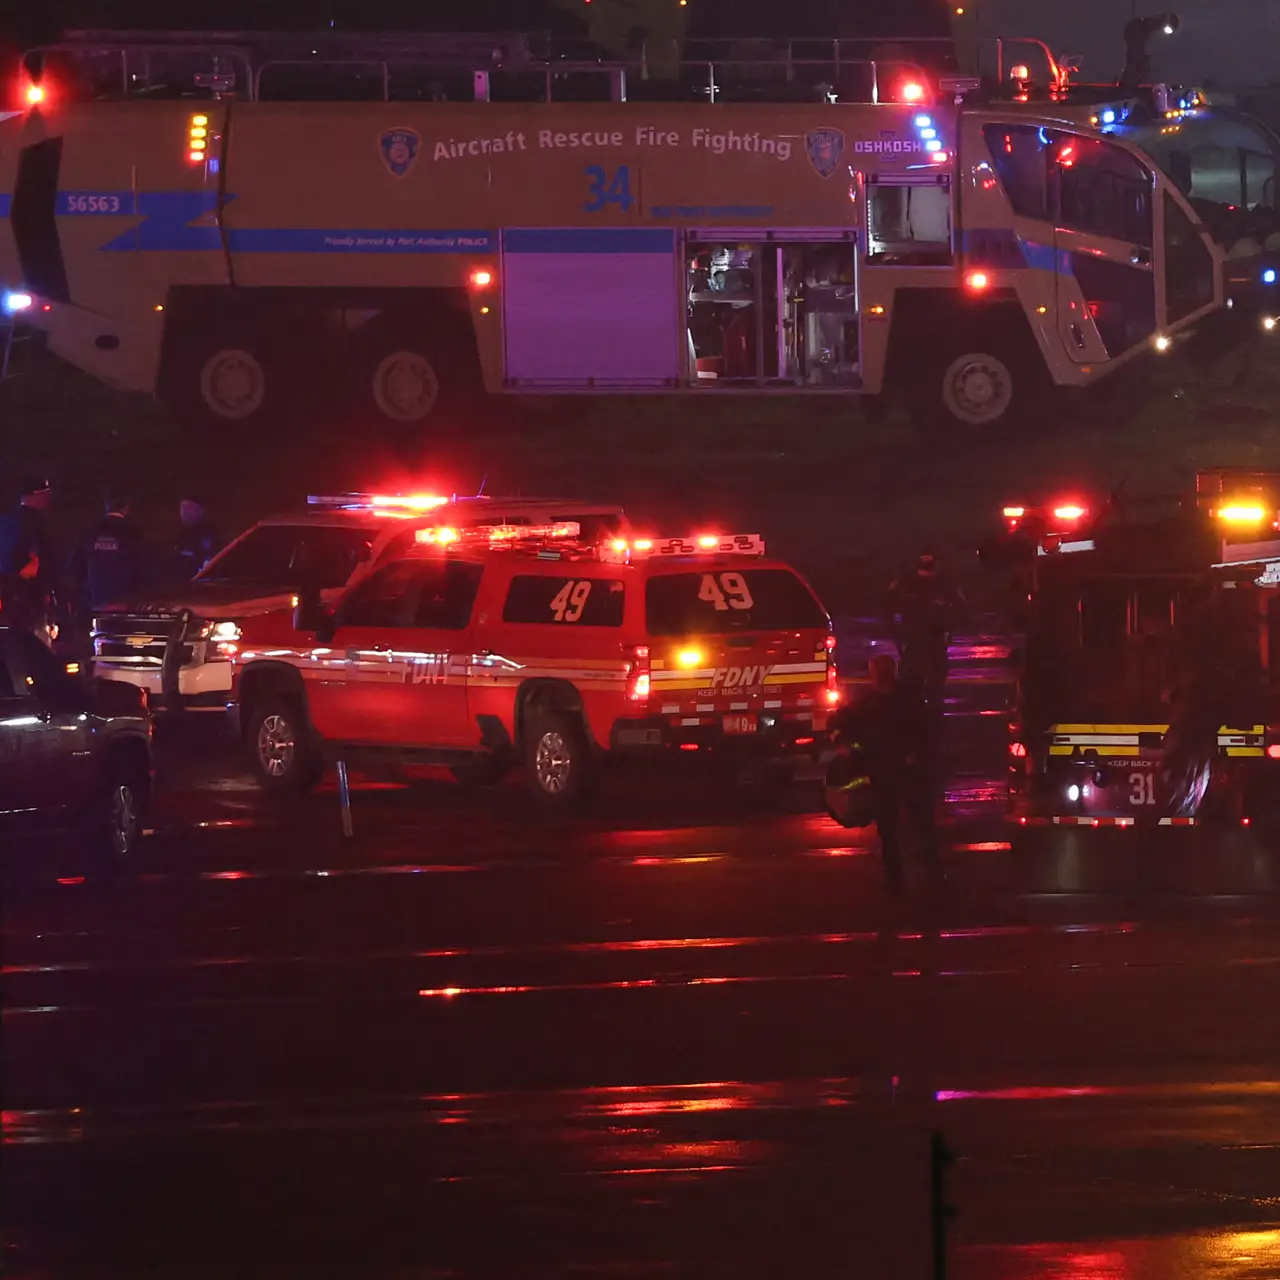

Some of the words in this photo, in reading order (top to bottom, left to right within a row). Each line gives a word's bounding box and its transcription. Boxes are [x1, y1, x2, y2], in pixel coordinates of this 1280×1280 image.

[433, 128, 528, 163] Aircraft
[538, 127, 624, 150] Rescue
[635, 125, 681, 148] Fire
[692, 128, 793, 161] Fighting
[854, 140, 921, 153] OSHKOSH
[67, 194, 120, 213] 56563
[583, 165, 635, 214] 34
[457, 237, 489, 246] POLICE
[549, 580, 592, 622] 49
[698, 572, 754, 611] 49
[711, 665, 774, 688] FDNY
[1128, 772, 1156, 806] 31
